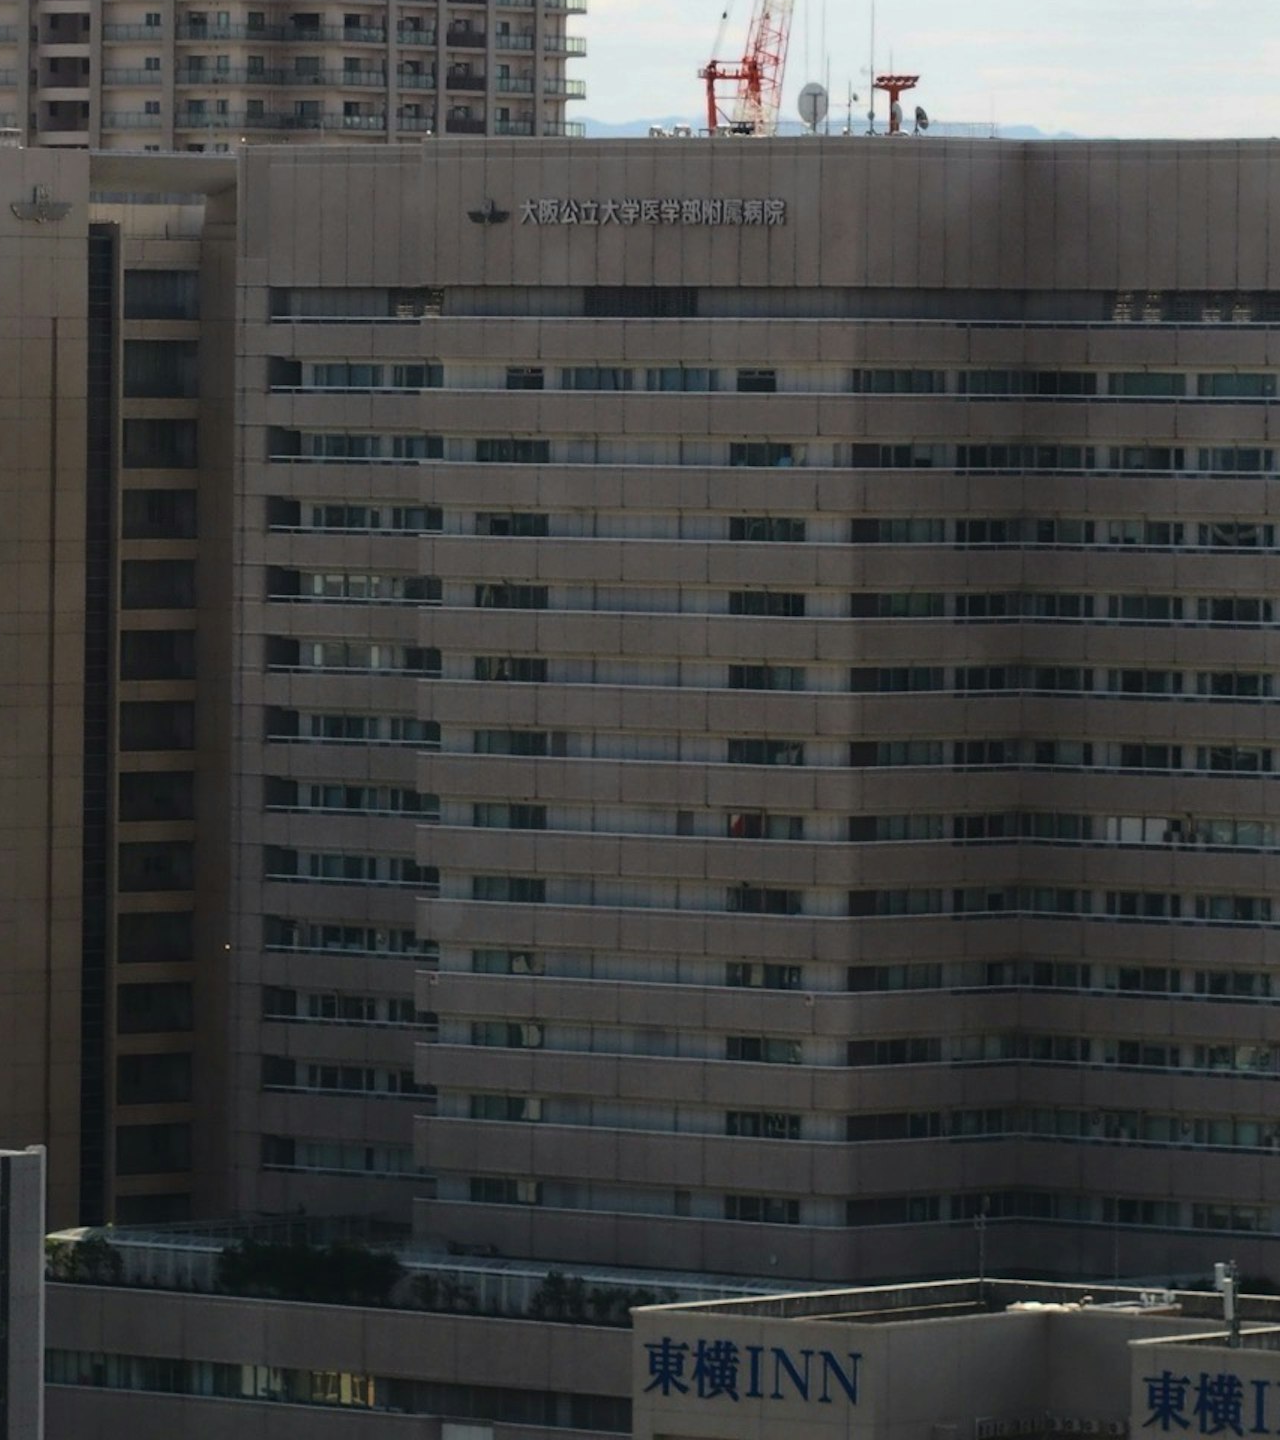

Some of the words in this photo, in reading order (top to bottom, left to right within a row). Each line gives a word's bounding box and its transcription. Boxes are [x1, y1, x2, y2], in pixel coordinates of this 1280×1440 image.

[520, 199, 785, 225] 大阪公立大学医学部附属病院
[643, 1337, 861, 1406] 東横INN
